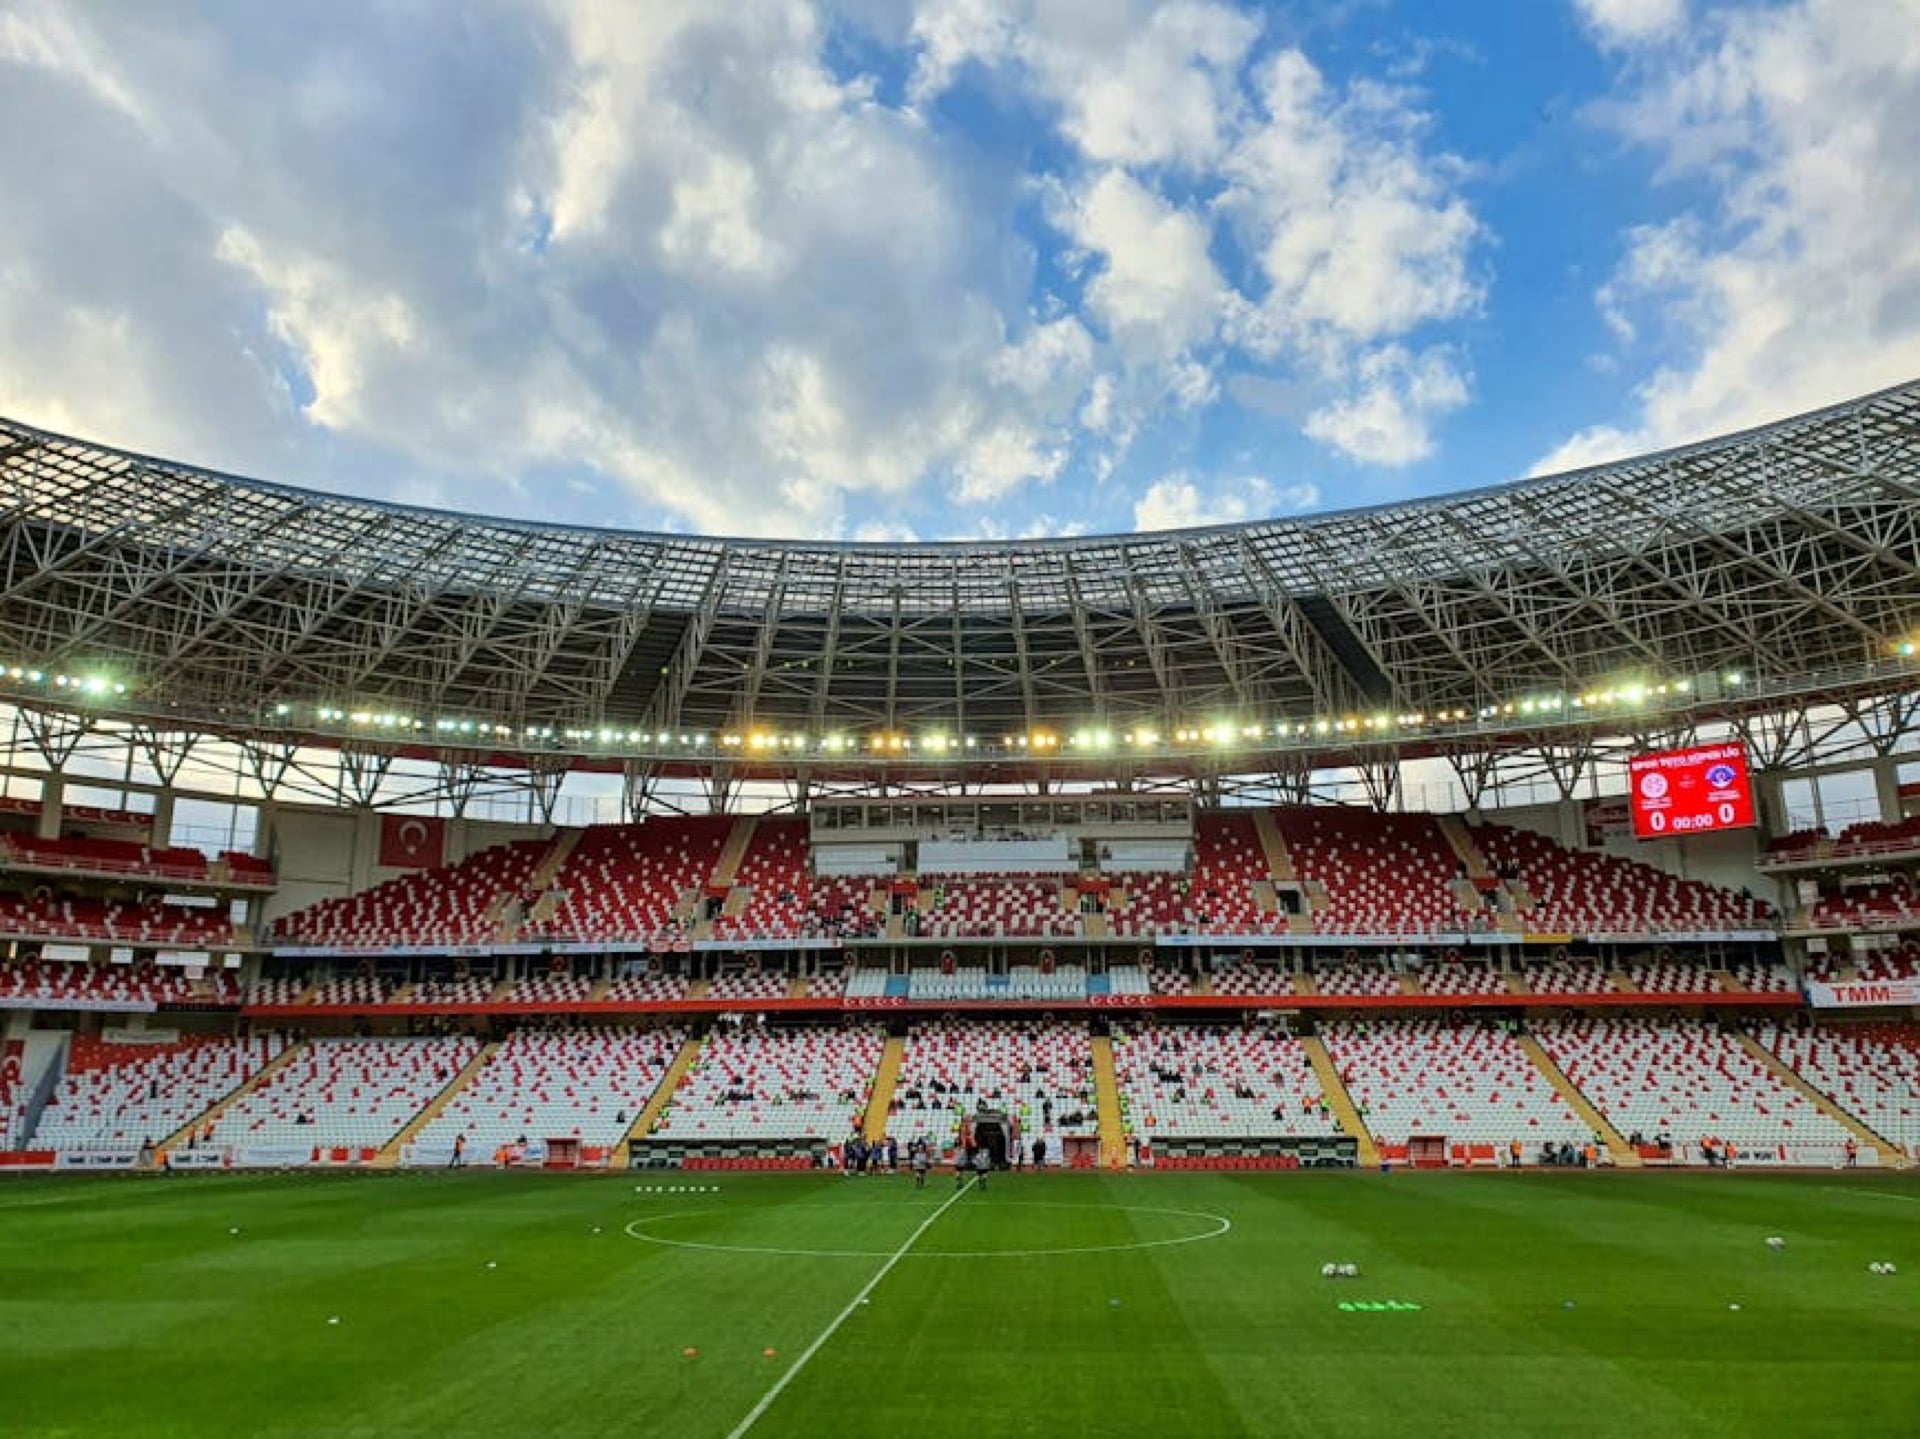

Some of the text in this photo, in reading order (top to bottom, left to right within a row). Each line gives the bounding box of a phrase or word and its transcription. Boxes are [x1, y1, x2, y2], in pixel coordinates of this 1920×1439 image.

[1650, 811, 1665, 831] 0
[1673, 815, 1713, 829] 00:00
[1718, 803, 1735, 823] 0
[1831, 986, 1890, 1003] TMM
